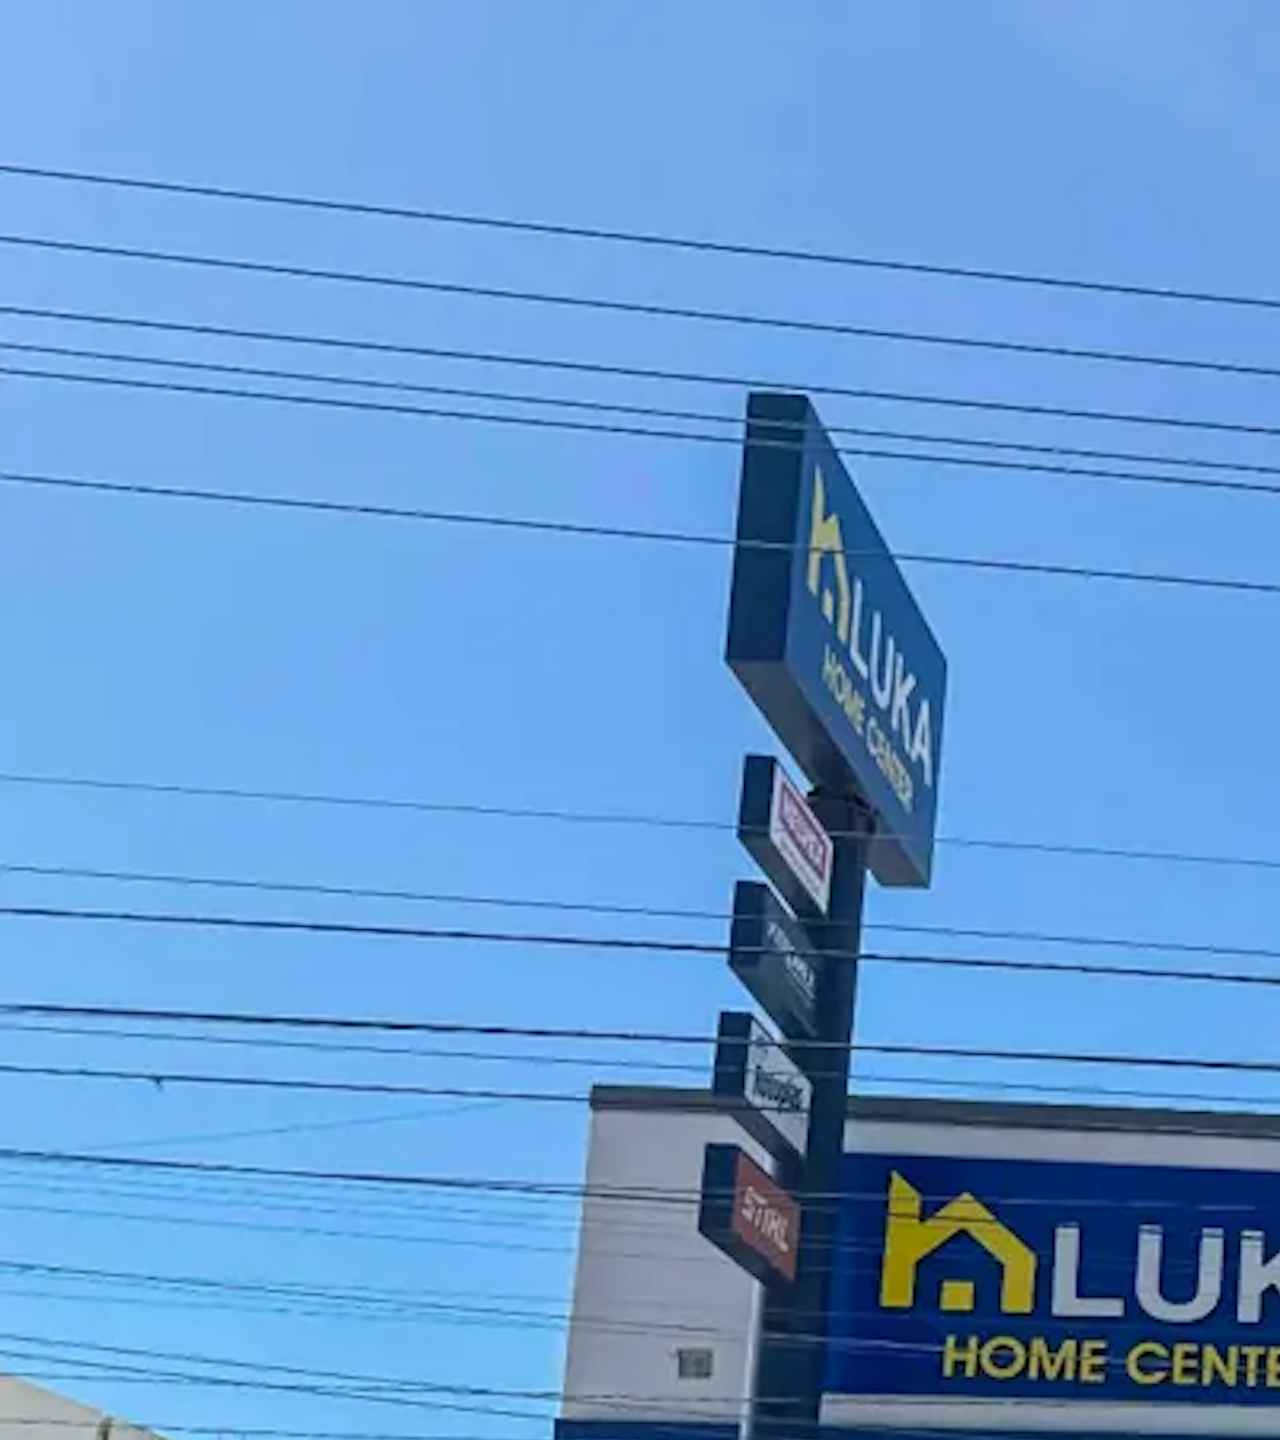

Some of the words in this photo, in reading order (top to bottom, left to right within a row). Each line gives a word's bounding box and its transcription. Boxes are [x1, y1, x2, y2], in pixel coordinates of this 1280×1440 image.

[821, 642, 866, 737] HOME
[866, 715, 914, 815] CENTER
[850, 575, 932, 788] LUKA
[941, 1334, 1107, 1384] HOME
